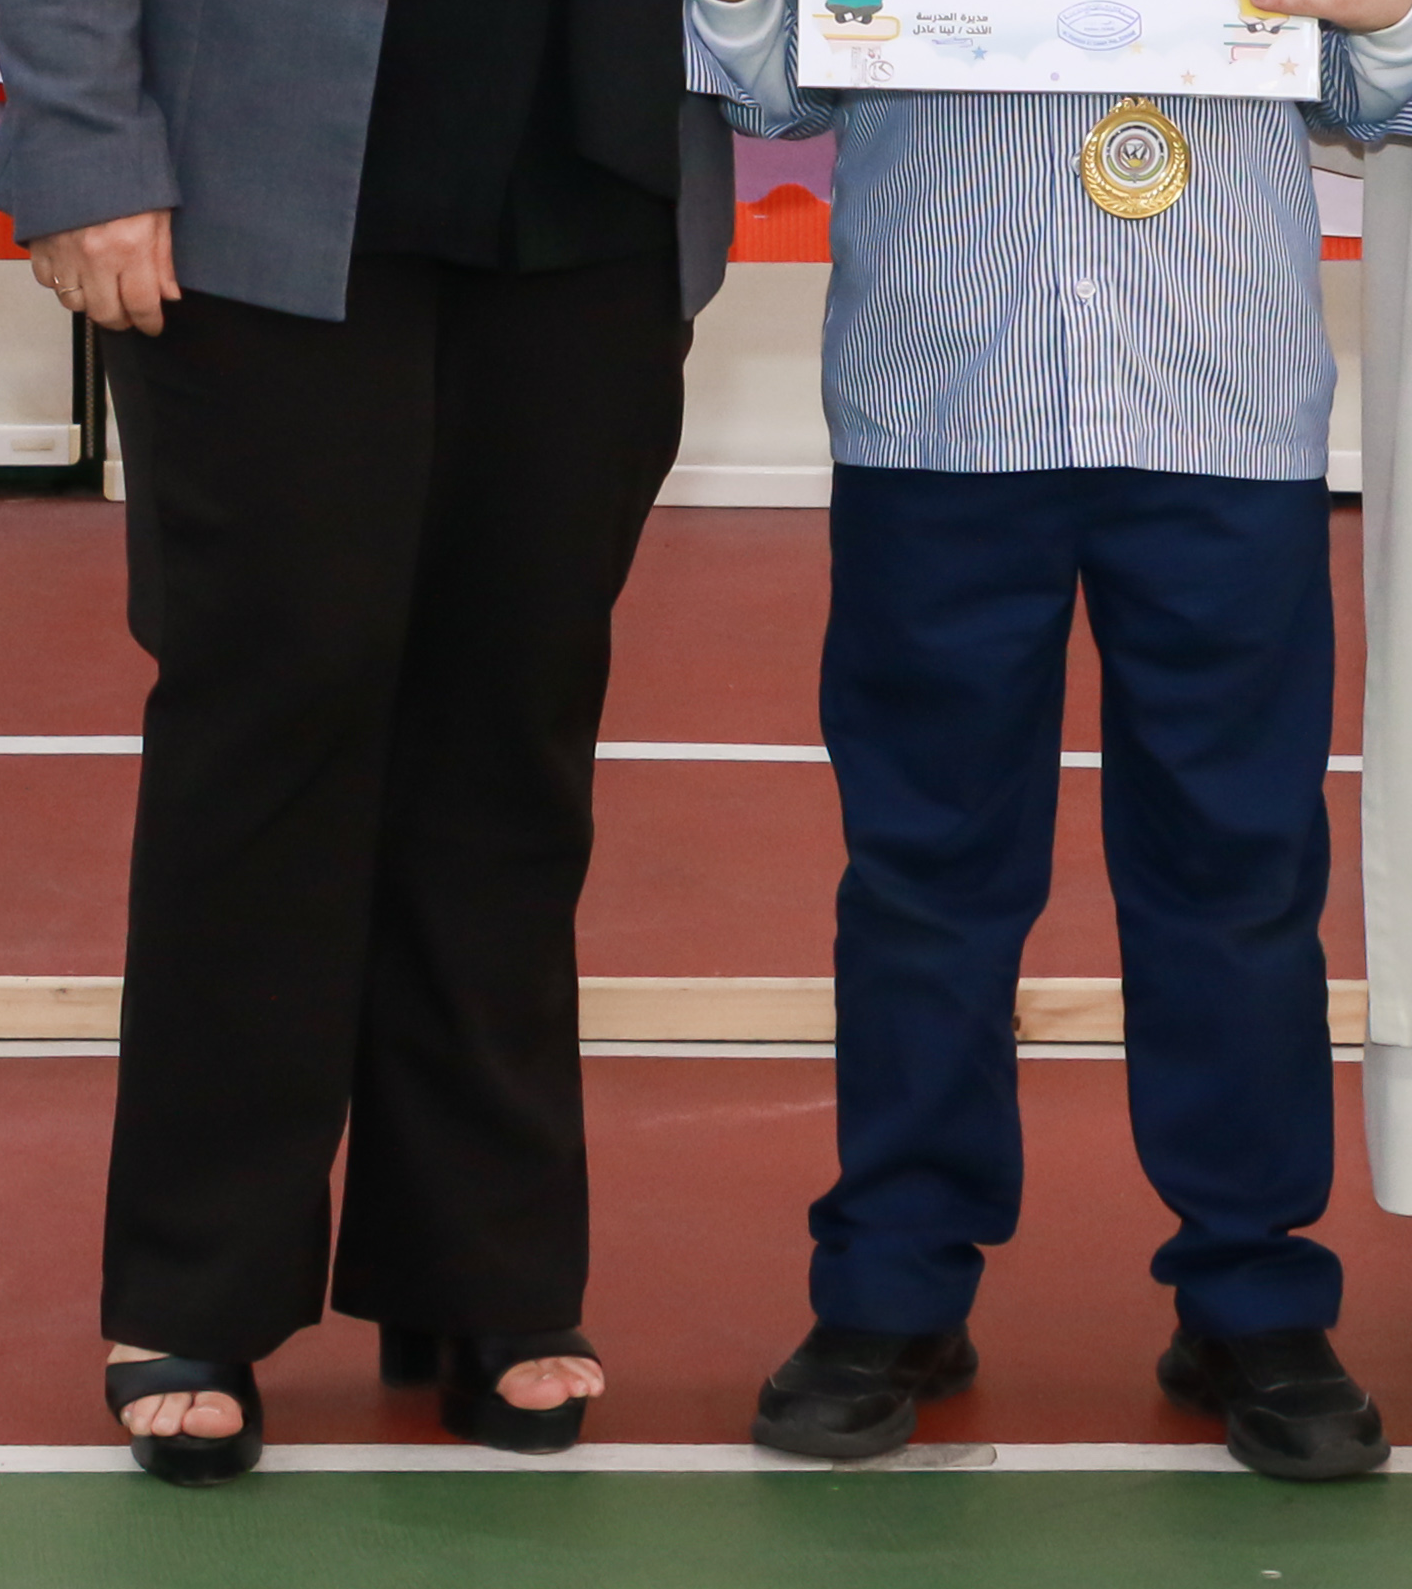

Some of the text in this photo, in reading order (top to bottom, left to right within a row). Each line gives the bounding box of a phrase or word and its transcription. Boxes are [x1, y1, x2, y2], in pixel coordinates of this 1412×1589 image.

[915, 12, 989, 24] مديرة المدرسة
[912, 24, 935, 36] عادل
[966, 25, 992, 35] الأخت
